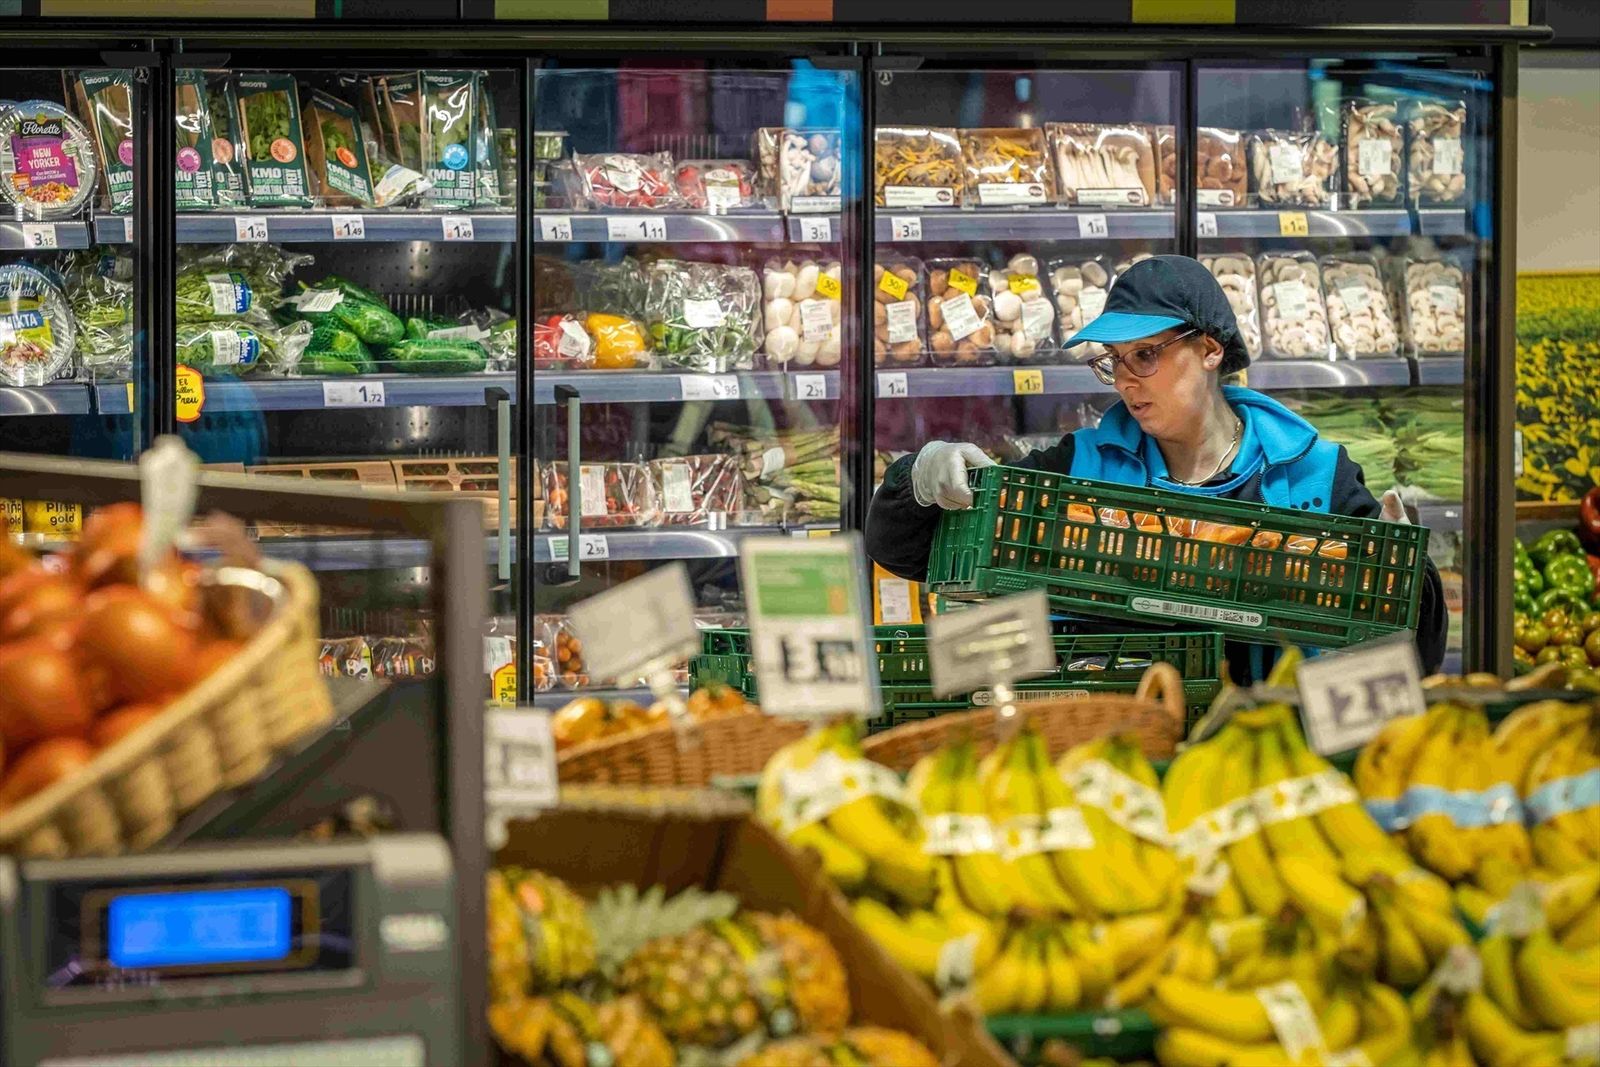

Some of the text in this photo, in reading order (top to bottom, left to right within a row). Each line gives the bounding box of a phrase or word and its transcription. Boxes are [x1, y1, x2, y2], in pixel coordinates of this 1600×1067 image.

[22, 121, 60, 135] Florette
[32, 147, 51, 159] NEW
[28, 157, 61, 169] YORKER
[248, 225, 266, 239] 1,49
[344, 223, 362, 236] 1,49
[454, 225, 471, 238] 1,49
[640, 220, 663, 239] 1,11
[34, 232, 54, 247] 3,15
[178, 377, 189, 386] El
[359, 385, 382, 403] 1,72
[50, 513, 75, 526] gold
